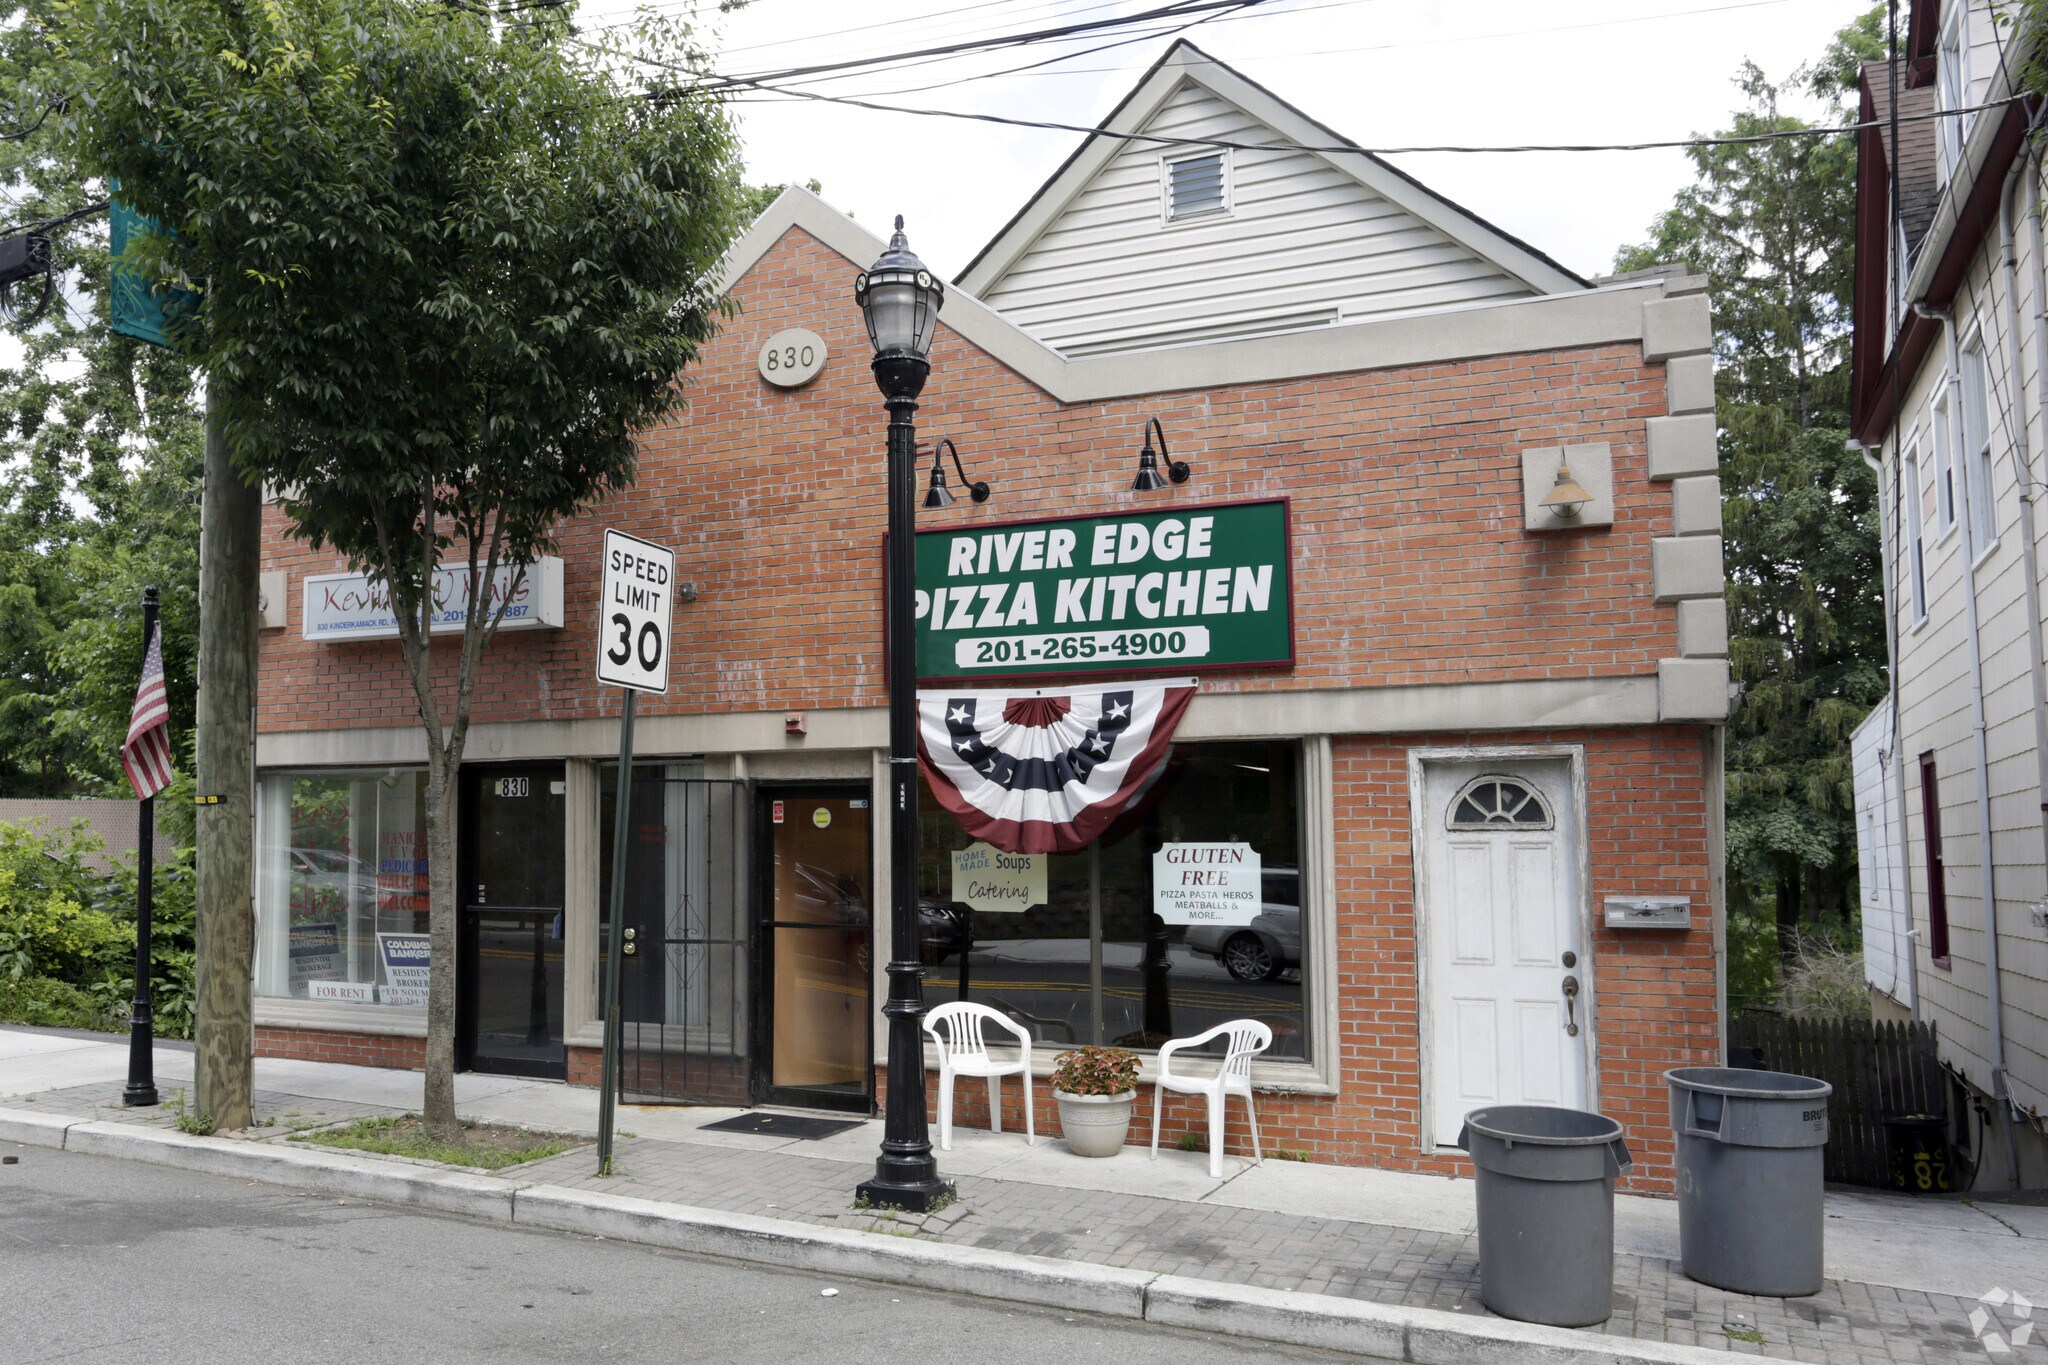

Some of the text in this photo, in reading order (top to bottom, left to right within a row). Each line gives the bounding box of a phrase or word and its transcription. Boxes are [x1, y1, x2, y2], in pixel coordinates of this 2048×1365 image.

[767, 345, 814, 371] 830
[947, 516, 1214, 577] RIVER EDGE
[611, 549, 668, 586] SPEED
[615, 581, 660, 613] LIMIT
[1053, 564, 1273, 624] KITCHEN
[317, 623, 328, 631] 830
[329, 619, 376, 630] KINDERKAMACK
[607, 612, 662, 673] 30
[977, 631, 1186, 663] 201-265-4900
[503, 778, 527, 796] 830
[955, 850, 986, 863] HOME
[960, 853, 1031, 874] MADE Soups
[1166, 848, 1244, 864] GLUTEN
[1181, 870, 1229, 886] FREE
[968, 880, 1029, 904] Catering
[1160, 890, 1254, 900] PIZZA PASTA HEROS
[1175, 901, 1239, 910] MEATBALLS &
[1188, 911, 1224, 920] MORE...
[316, 986, 365, 999] FOR RENT
